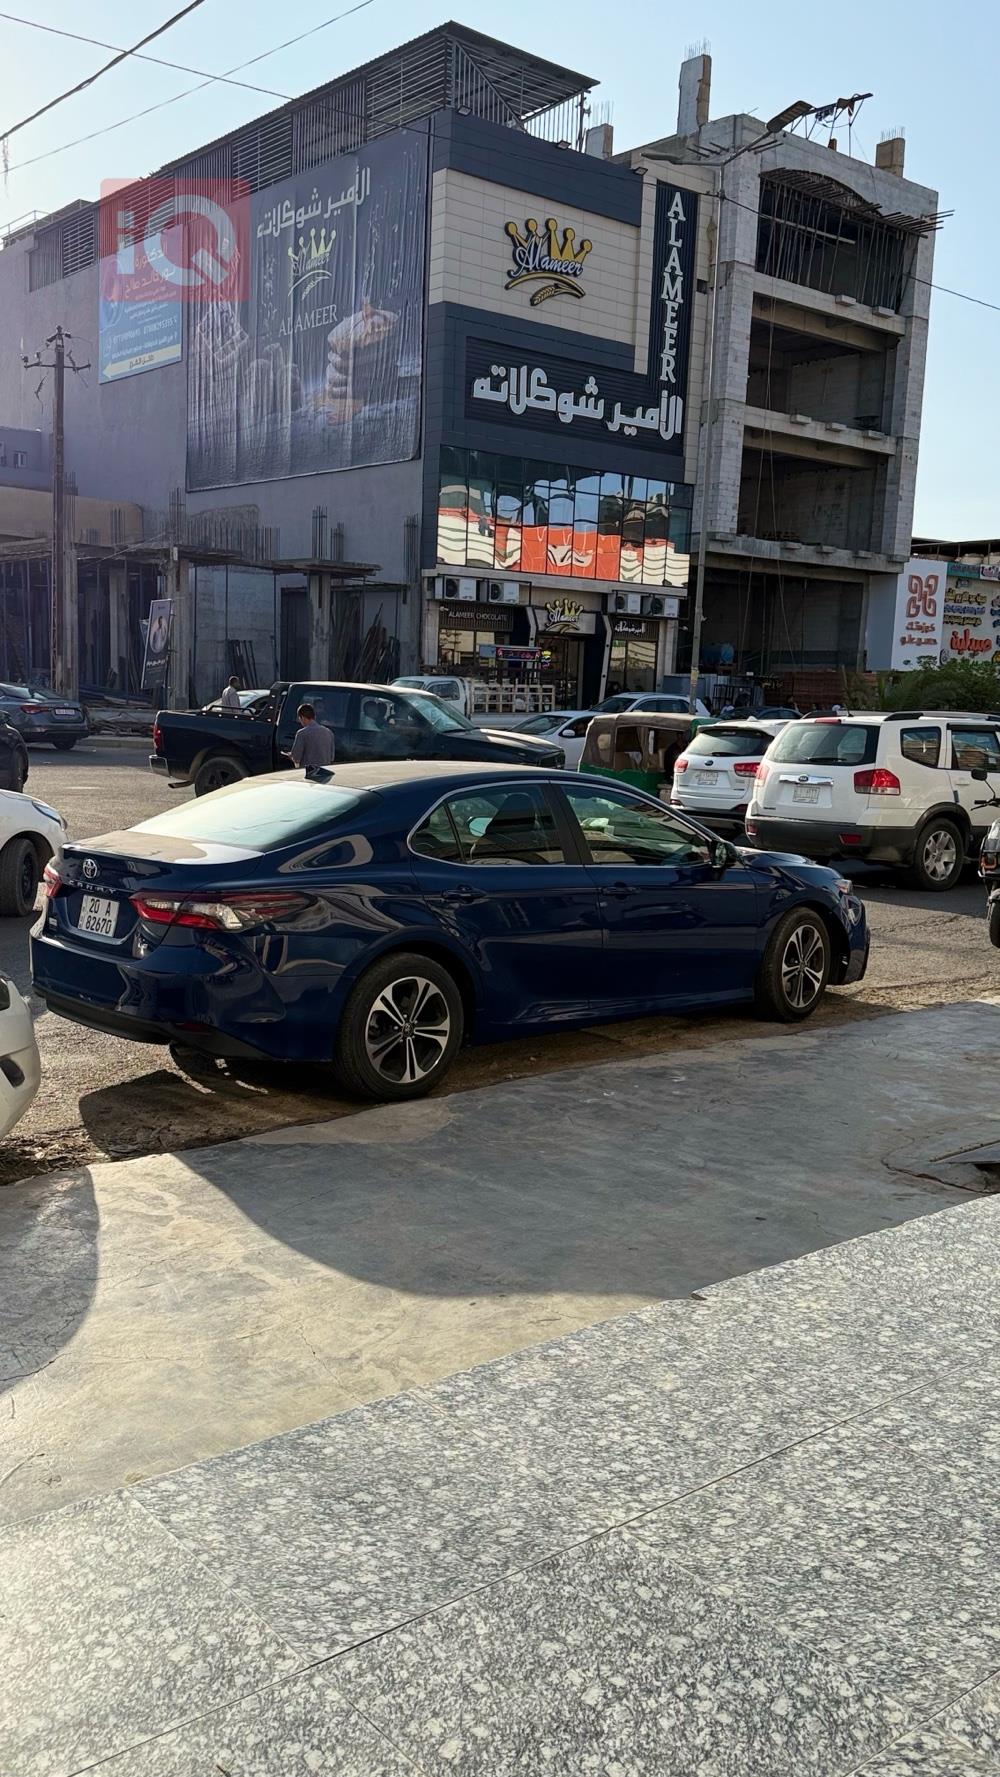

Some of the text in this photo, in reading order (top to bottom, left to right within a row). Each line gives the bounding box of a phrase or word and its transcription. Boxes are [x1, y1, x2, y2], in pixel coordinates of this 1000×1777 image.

[510, 231, 583, 277] Alameer
[659, 191, 687, 384] ALAMEER
[473, 364, 683, 441] الأمير شوكلاته
[449, 611, 509, 621] ALAMEER CHOCOLATE
[88, 898, 101, 914] 20
[104, 901, 112, 917] A
[85, 915, 113, 934] 82670
